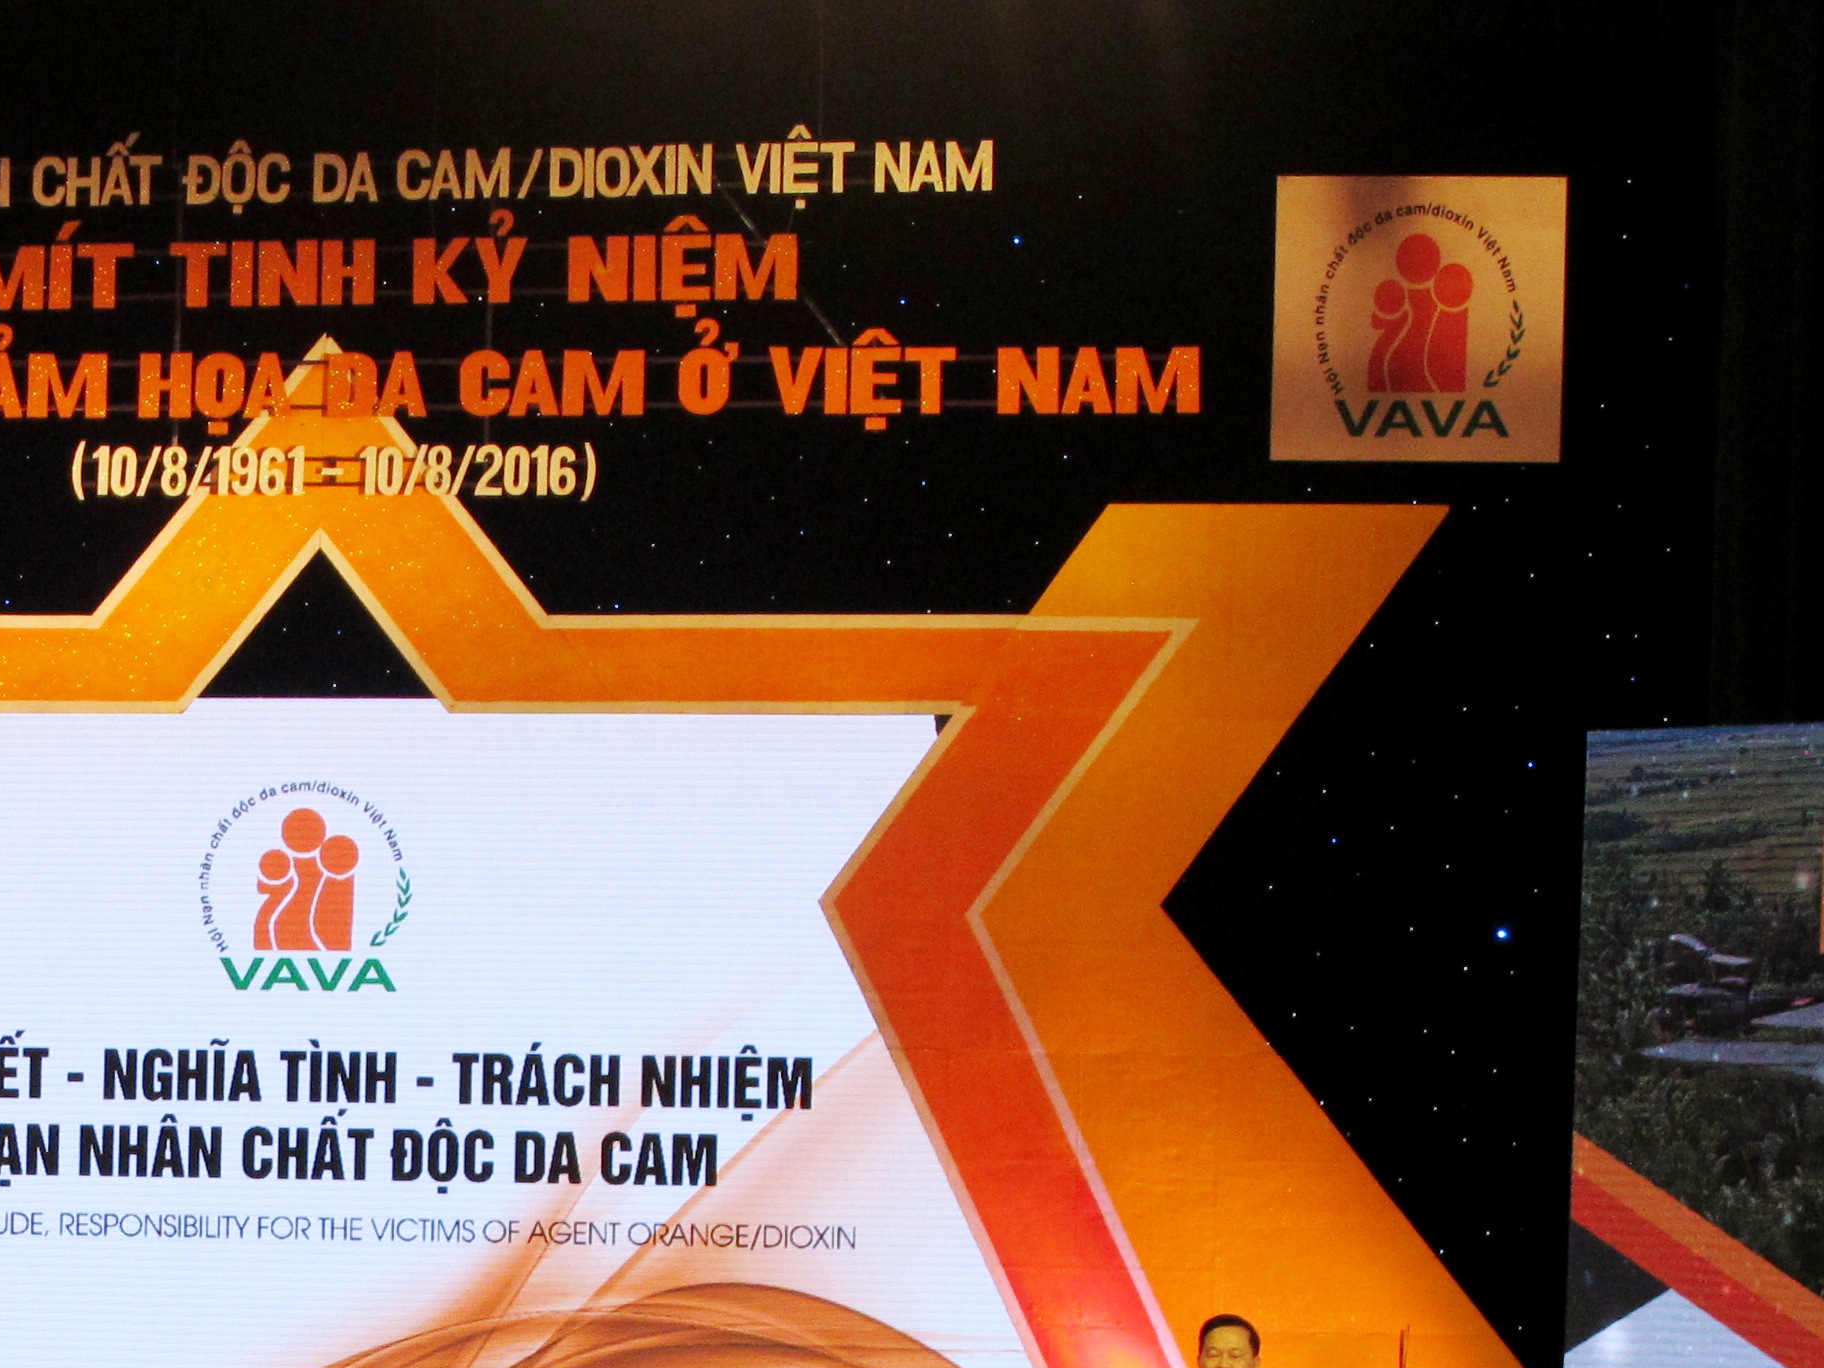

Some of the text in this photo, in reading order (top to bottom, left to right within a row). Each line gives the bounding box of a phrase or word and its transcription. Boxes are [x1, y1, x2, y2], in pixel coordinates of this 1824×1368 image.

[31, 132, 162, 207] CHẤT
[183, 140, 290, 214] ĐỘC
[313, 150, 379, 202] DA
[396, 144, 713, 200] CAM/DIOXIN
[735, 125, 855, 209] VIỆT
[874, 140, 993, 193] NAM
[170, 239, 375, 307] TINH
[412, 209, 526, 305] KỶ
[567, 215, 797, 317] NIỆM
[139, 352, 291, 434] HỌA
[323, 351, 427, 417] DA
[460, 349, 645, 416] CAM
[678, 319, 737, 414] Ở
[770, 329, 955, 430] VIỆT
[996, 346, 1200, 414] NAM
[1335, 399, 1510, 438] VAVA
[72, 441, 305, 499] (10/8/1961
[359, 442, 596, 499] 10/8/2016)
[219, 957, 397, 992] VAVA
[104, 1038, 261, 1102] NGHĨA
[280, 1038, 397, 1104] TÌNH
[453, 1042, 620, 1108] TRÁCH
[641, 1045, 813, 1122] NHIỆM
[79, 1114, 221, 1178] NHÂN
[241, 1109, 374, 1180] CHẤT
[390, 1118, 493, 1194] ĐỘC
[514, 1131, 581, 1185] DA
[600, 1133, 717, 1187] CAM
[60, 1213, 250, 1240] RESPONSIBILITY
[258, 1217, 310, 1240] FOR
[319, 1218, 363, 1242] THE
[371, 1218, 476, 1243] VICTIMS
[482, 1220, 521, 1244] OF
[528, 1221, 621, 1245] AGENT
[627, 1222, 857, 1250] ORANGE/DIOXIN
